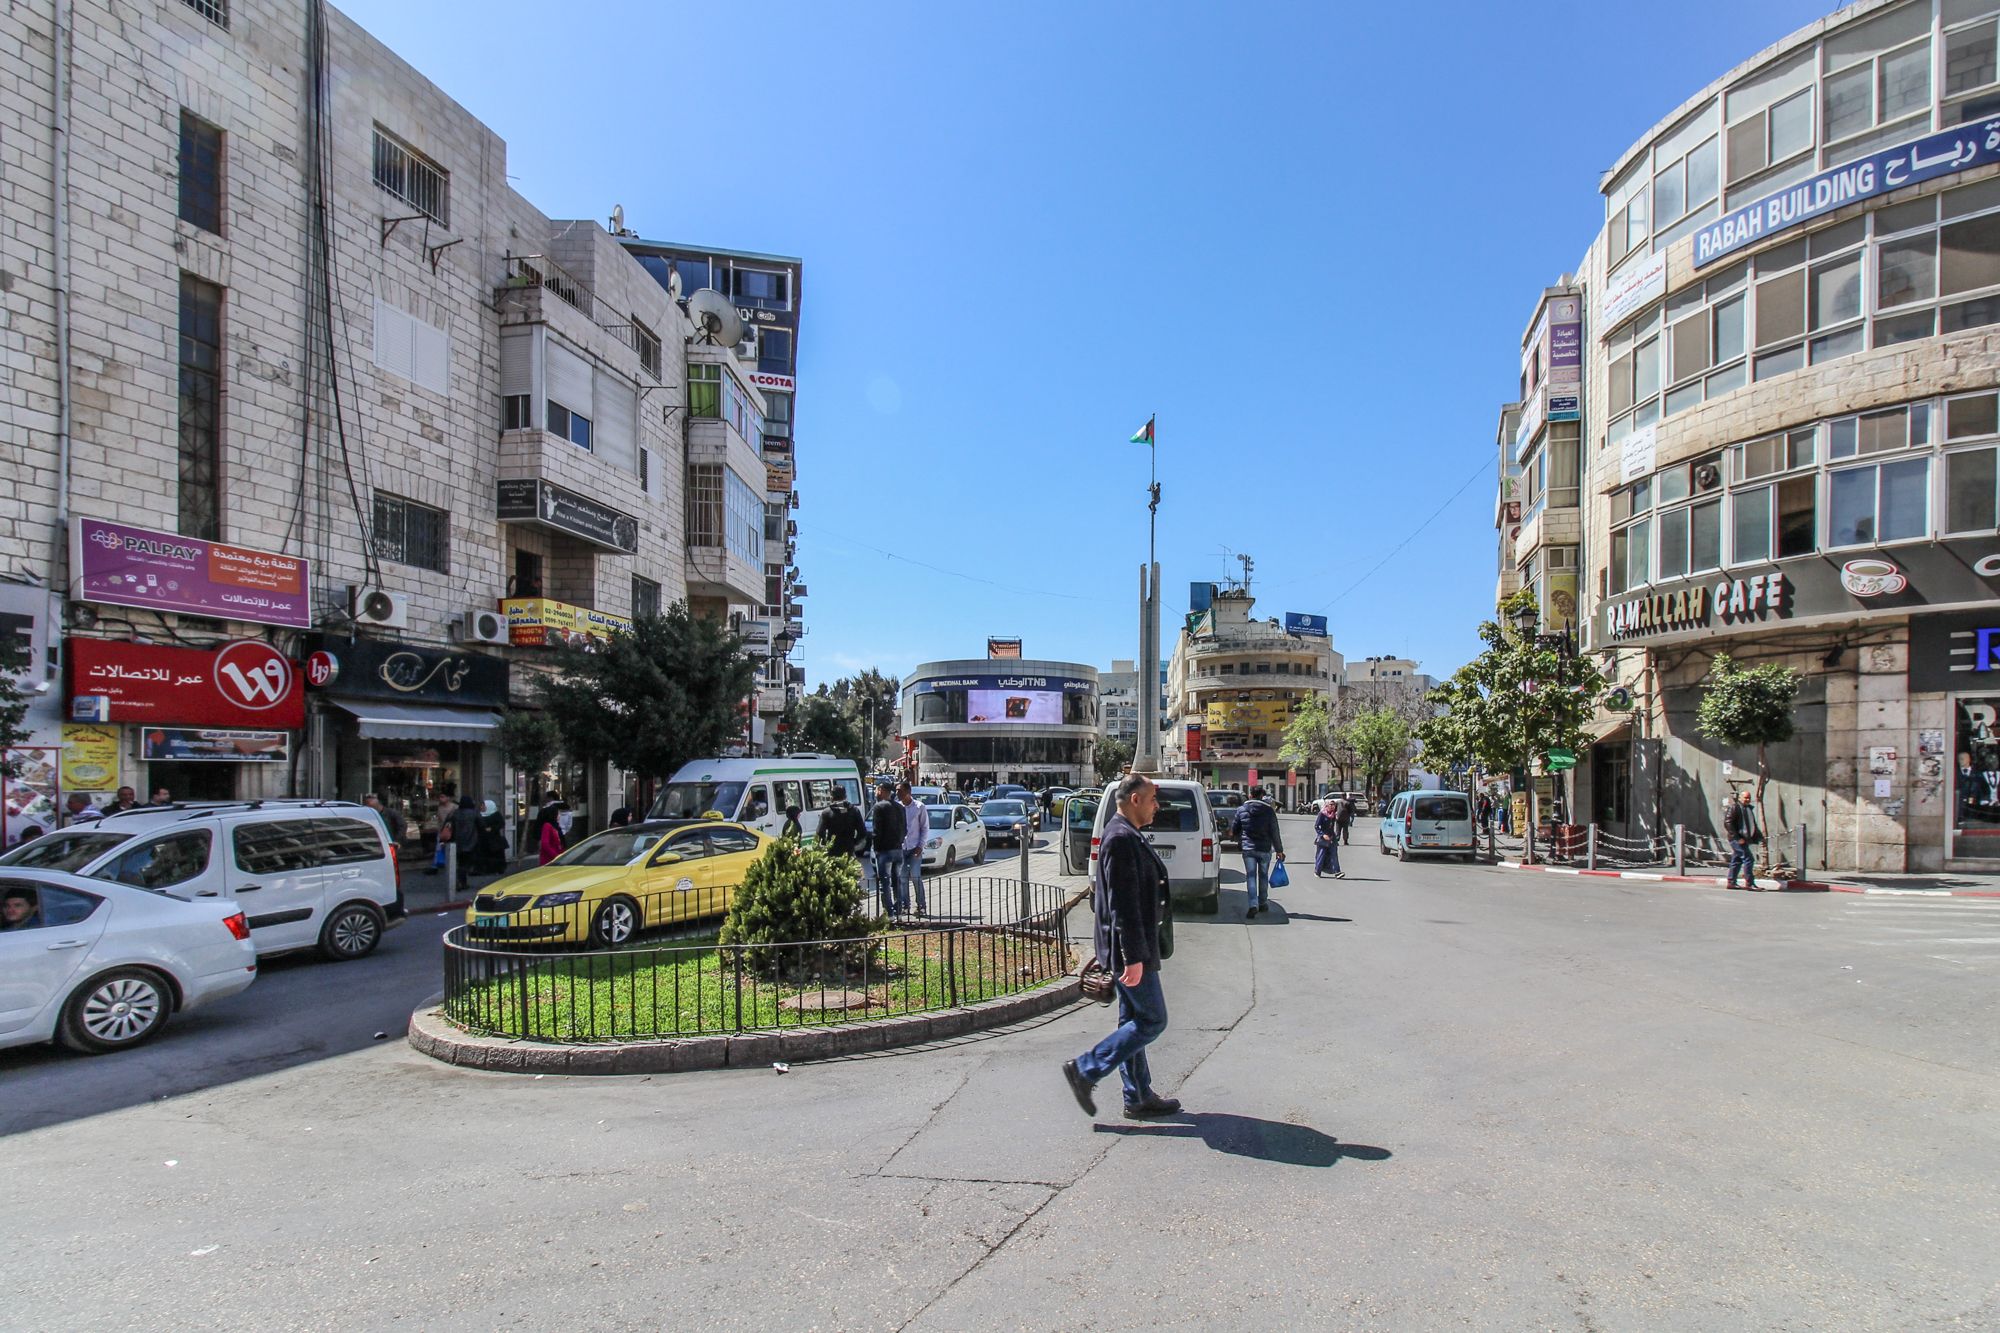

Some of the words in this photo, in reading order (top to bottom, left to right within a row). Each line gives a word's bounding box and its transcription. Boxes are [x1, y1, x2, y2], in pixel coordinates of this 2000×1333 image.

[1884, 139, 1977, 186] رباح
[1699, 204, 1763, 260] RABAH
[1767, 162, 1875, 229] BUILDING
[757, 311, 776, 322] Cafe
[757, 375, 793, 388] COSTA
[124, 536, 196, 561] PALPAY
[212, 547, 253, 564] معتمدة
[253, 556, 270, 569] بيع
[270, 556, 297, 571] نقطة
[271, 601, 292, 610] عمر
[1607, 585, 1707, 636] RAMALLAH
[1713, 572, 1784, 616] CAFE
[89, 664, 170, 681] للاتصالات
[174, 675, 204, 686] عمر
[1027, 677, 1046, 687] TNB
